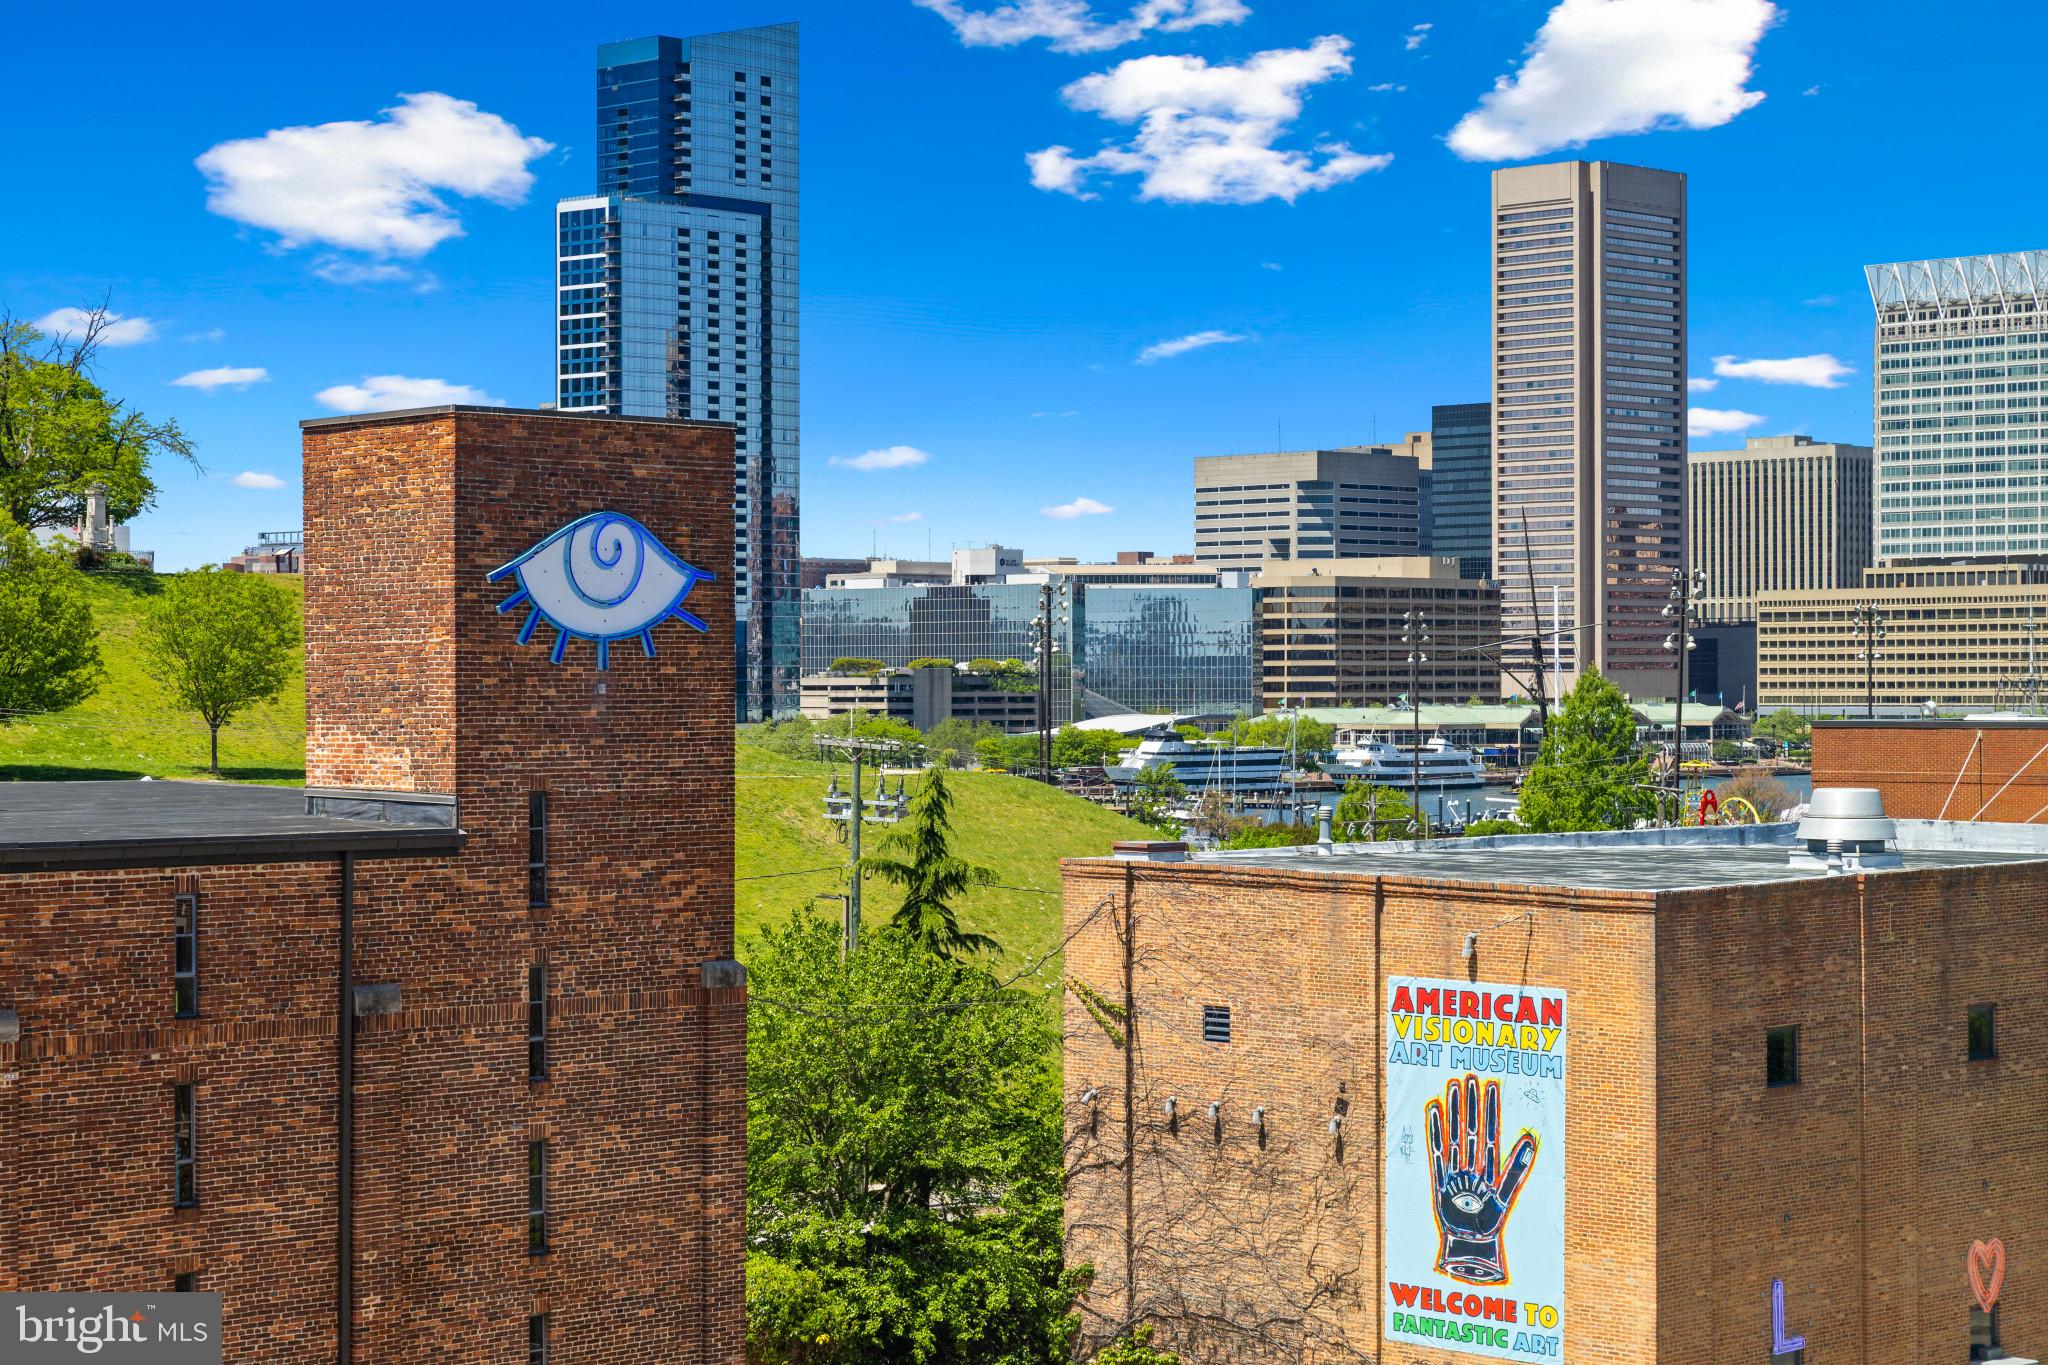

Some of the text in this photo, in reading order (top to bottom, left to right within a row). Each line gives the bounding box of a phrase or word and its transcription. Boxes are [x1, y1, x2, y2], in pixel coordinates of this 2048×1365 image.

[1391, 985, 1563, 1027] AMERICAN
[1391, 1013, 1562, 1052] VISIONARY
[1389, 1040, 1563, 1080] ART MUSEUM
[1388, 1281, 1559, 1329] WELCOME TO
[1392, 1312, 1559, 1357] FANTASTIC ART
